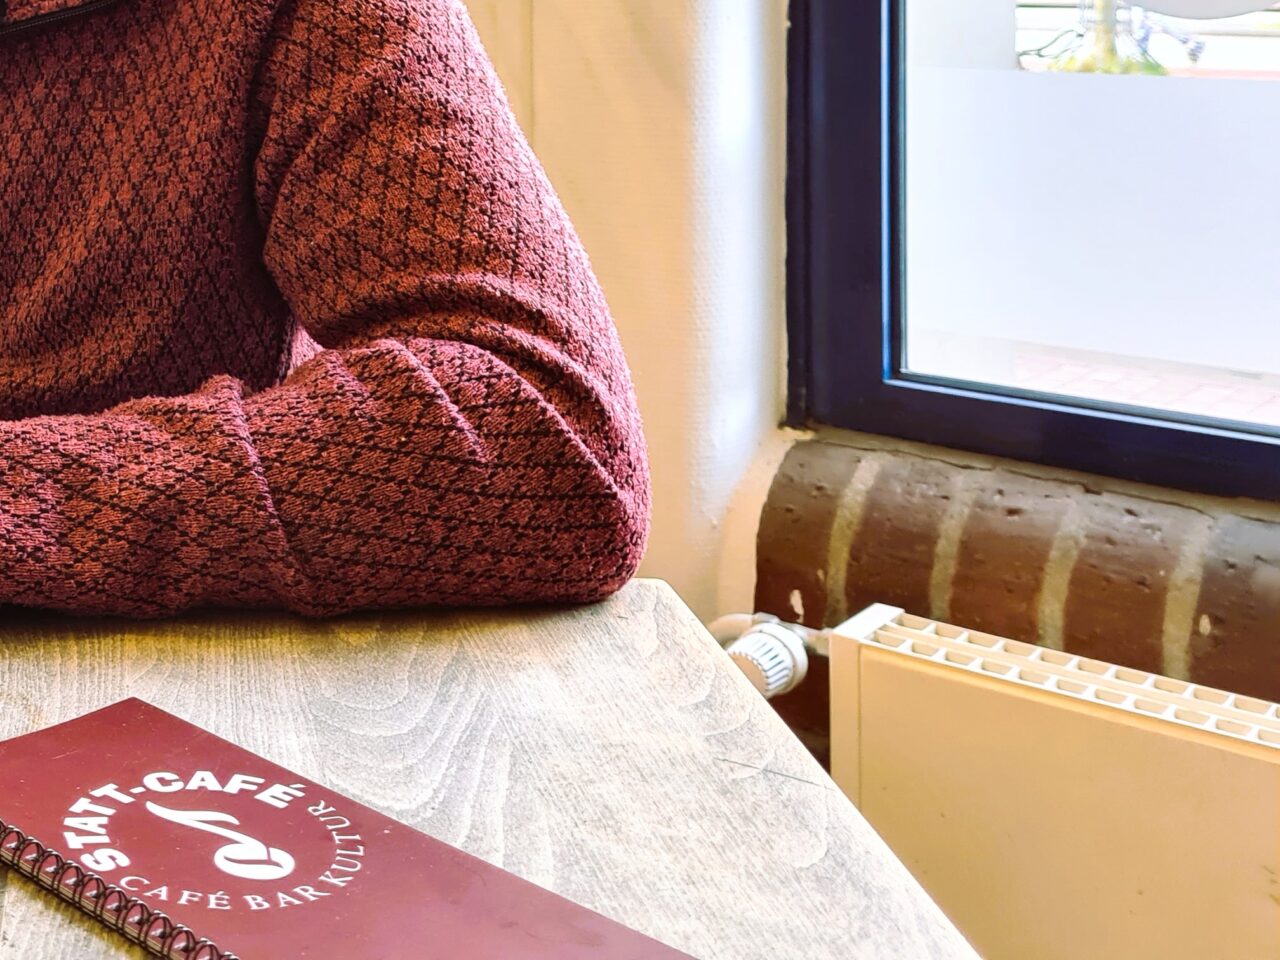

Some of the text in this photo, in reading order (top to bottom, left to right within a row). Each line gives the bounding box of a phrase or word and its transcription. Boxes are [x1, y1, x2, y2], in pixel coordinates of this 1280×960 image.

[63, 770, 307, 872] STATT-CAFÉ
[120, 799, 366, 911] CAFÉ BAR KULTUR
